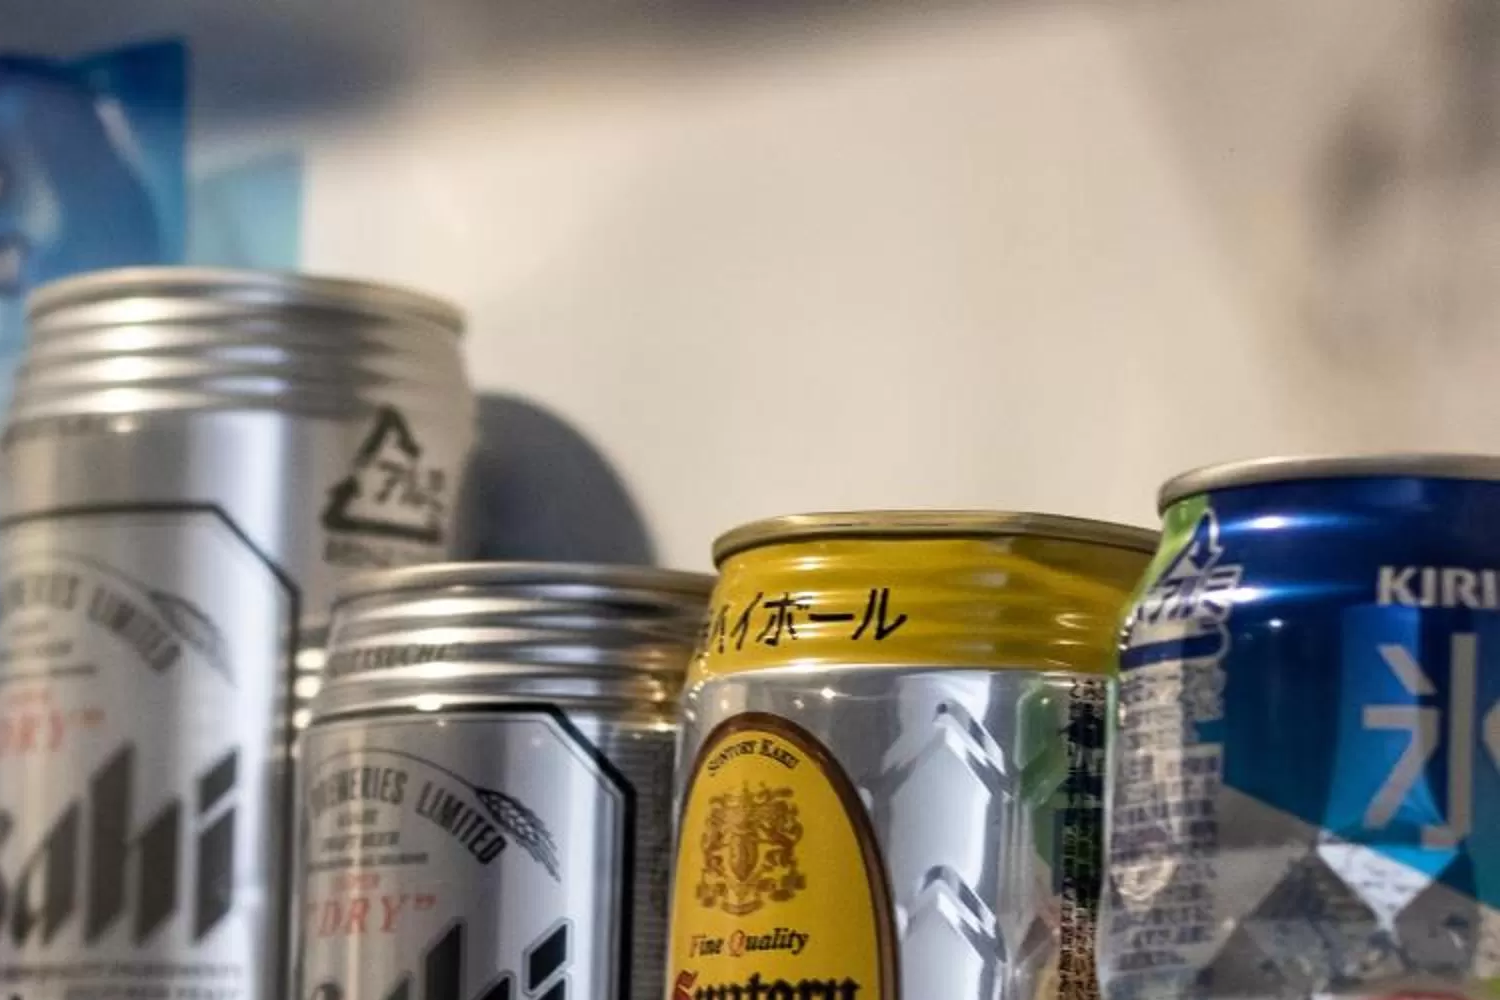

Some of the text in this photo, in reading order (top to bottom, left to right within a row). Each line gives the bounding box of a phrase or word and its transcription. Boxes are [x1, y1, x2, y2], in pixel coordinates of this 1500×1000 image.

[1376, 565, 1500, 609] KIRI
[415, 780, 508, 866] LIMITED
[690, 928, 810, 957] Fine Quality
